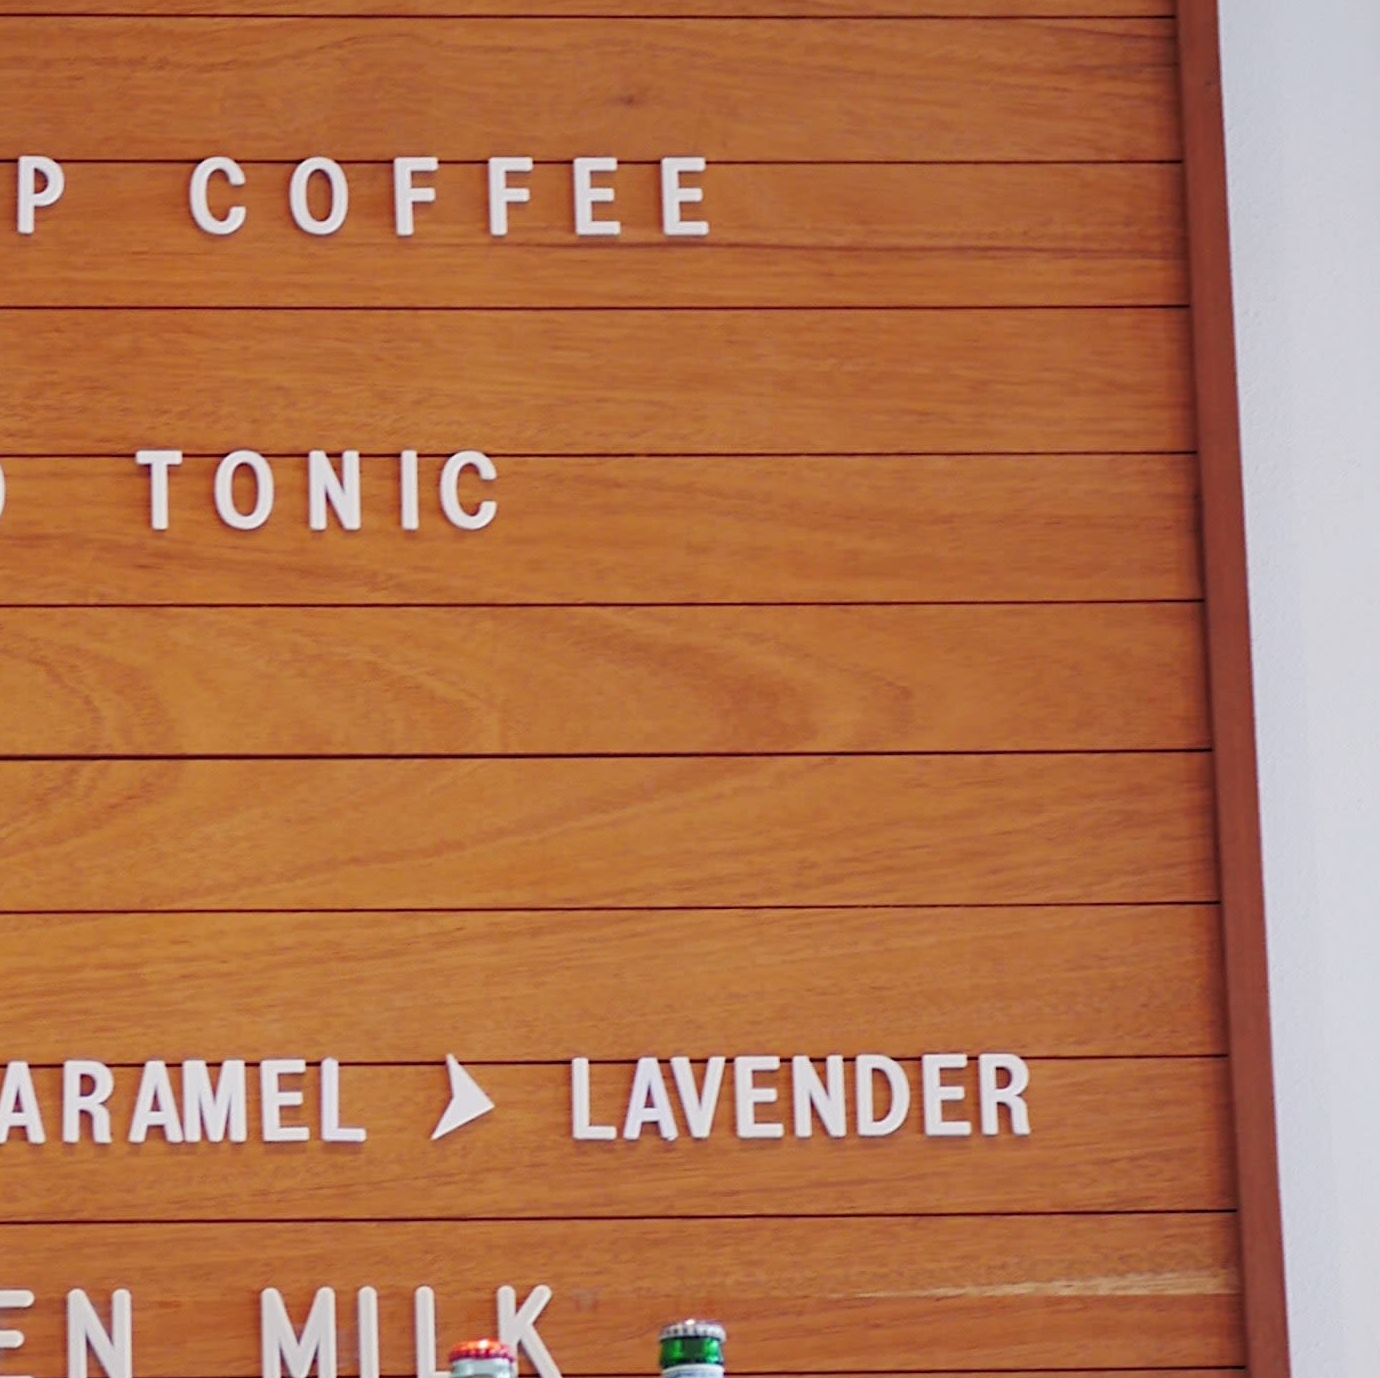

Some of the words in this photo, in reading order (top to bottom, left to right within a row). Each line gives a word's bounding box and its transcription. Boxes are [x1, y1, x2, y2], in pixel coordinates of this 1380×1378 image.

[189, 156, 710, 237] COFFEE
[134, 449, 497, 531] TONIC
[570, 1052, 1031, 1142] LAVENDER
